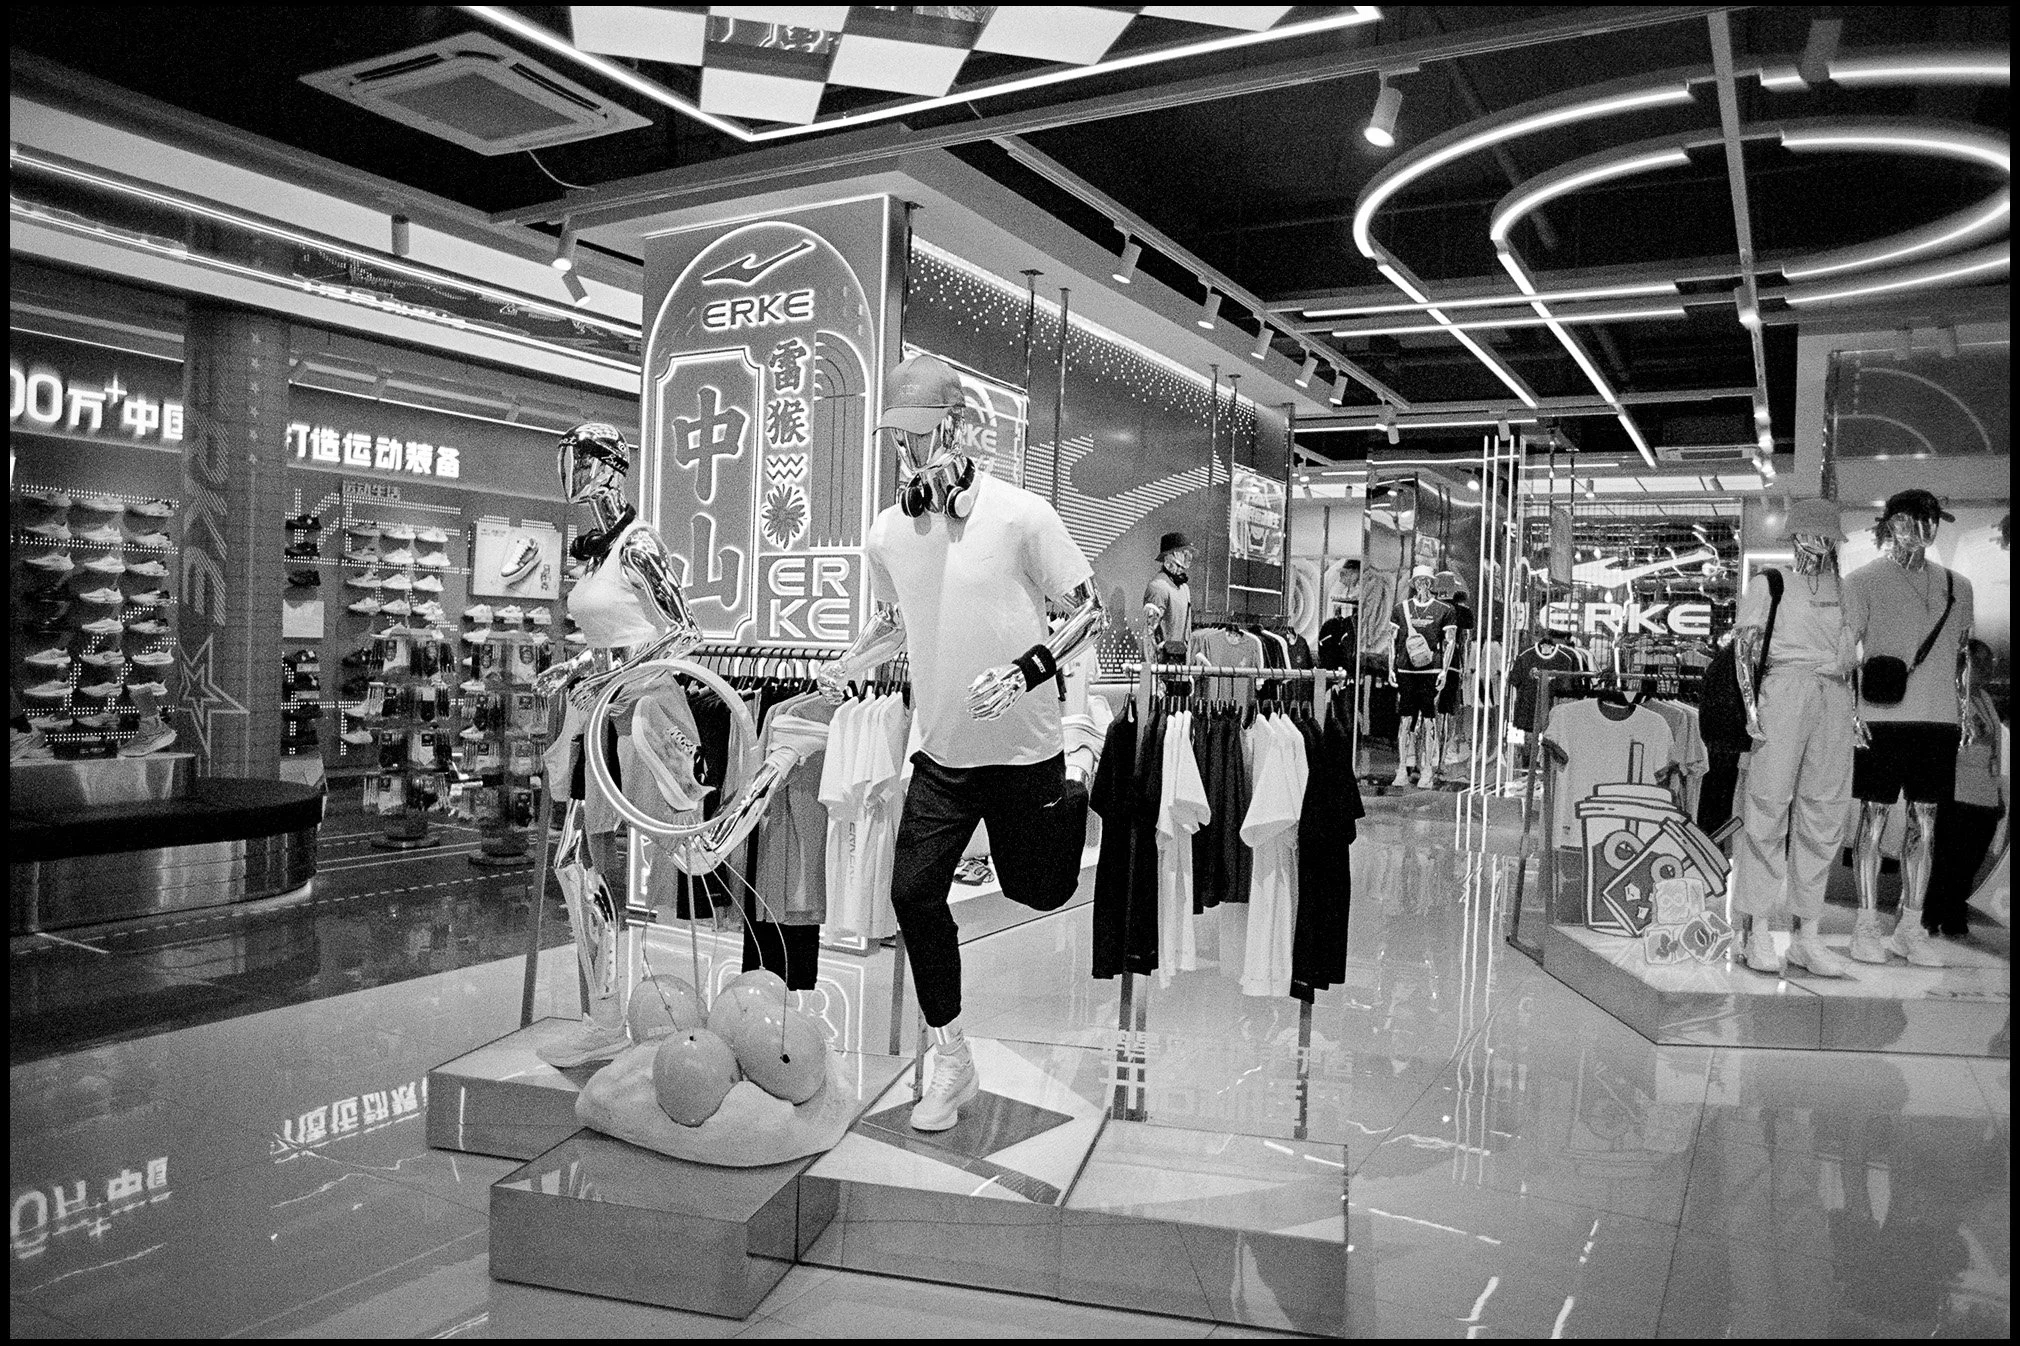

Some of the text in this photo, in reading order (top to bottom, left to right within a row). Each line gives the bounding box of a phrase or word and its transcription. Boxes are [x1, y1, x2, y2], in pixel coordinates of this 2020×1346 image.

[701, 288, 815, 333] ERKE
[765, 337, 811, 448] 雷猴
[286, 423, 461, 478] 打造运动装备
[671, 384, 751, 611] 中山
[768, 557, 850, 597] ER
[769, 598, 851, 641] KE
[1539, 601, 1712, 636] ERKE
